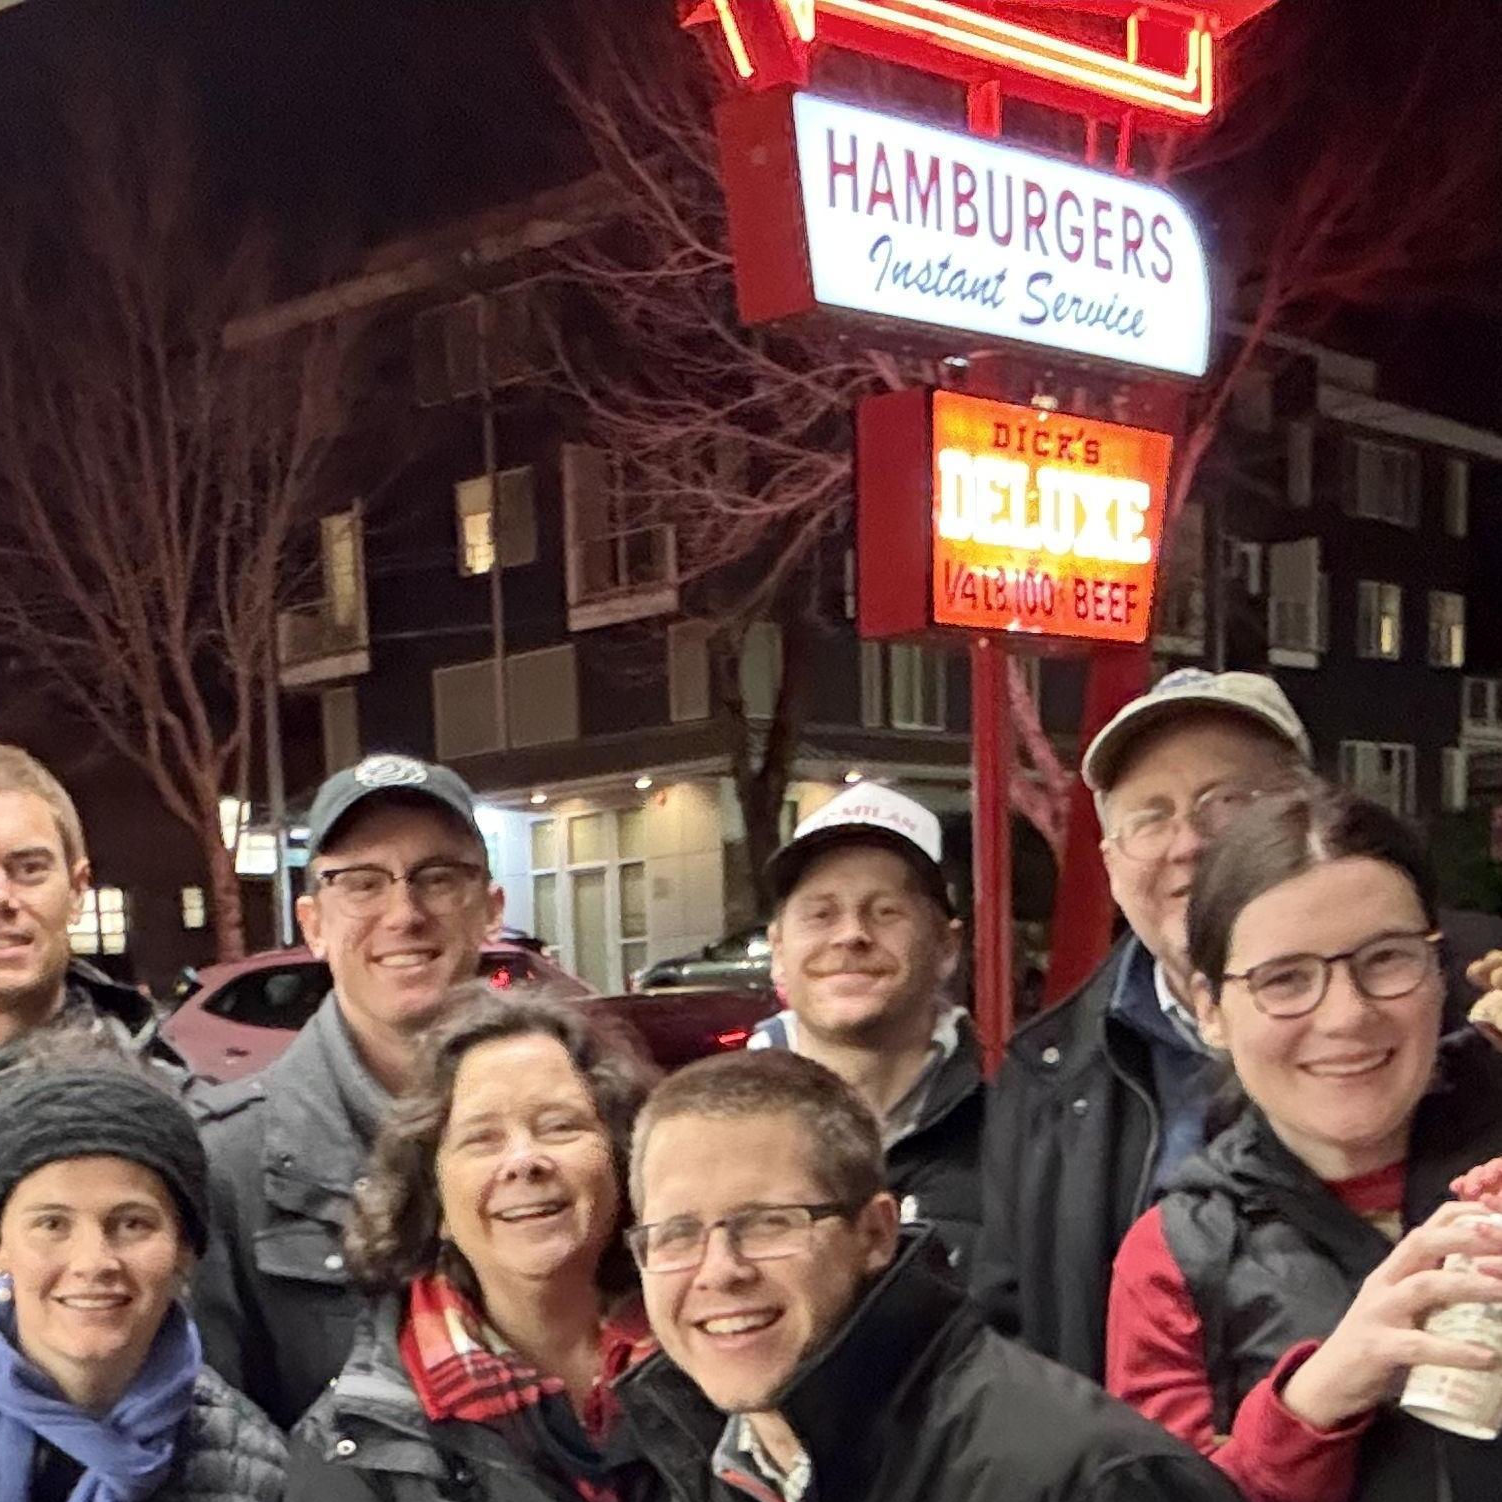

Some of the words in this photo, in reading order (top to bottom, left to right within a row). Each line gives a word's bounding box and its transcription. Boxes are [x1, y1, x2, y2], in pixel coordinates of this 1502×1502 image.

[826, 127, 1174, 284] HAMBURGERS
[868, 234, 1007, 309] Instant
[1019, 271, 1147, 339] Service
[993, 421, 1102, 465] DICK'S
[938, 448, 1151, 565] DELUXE
[1074, 577, 1139, 624] BEEF
